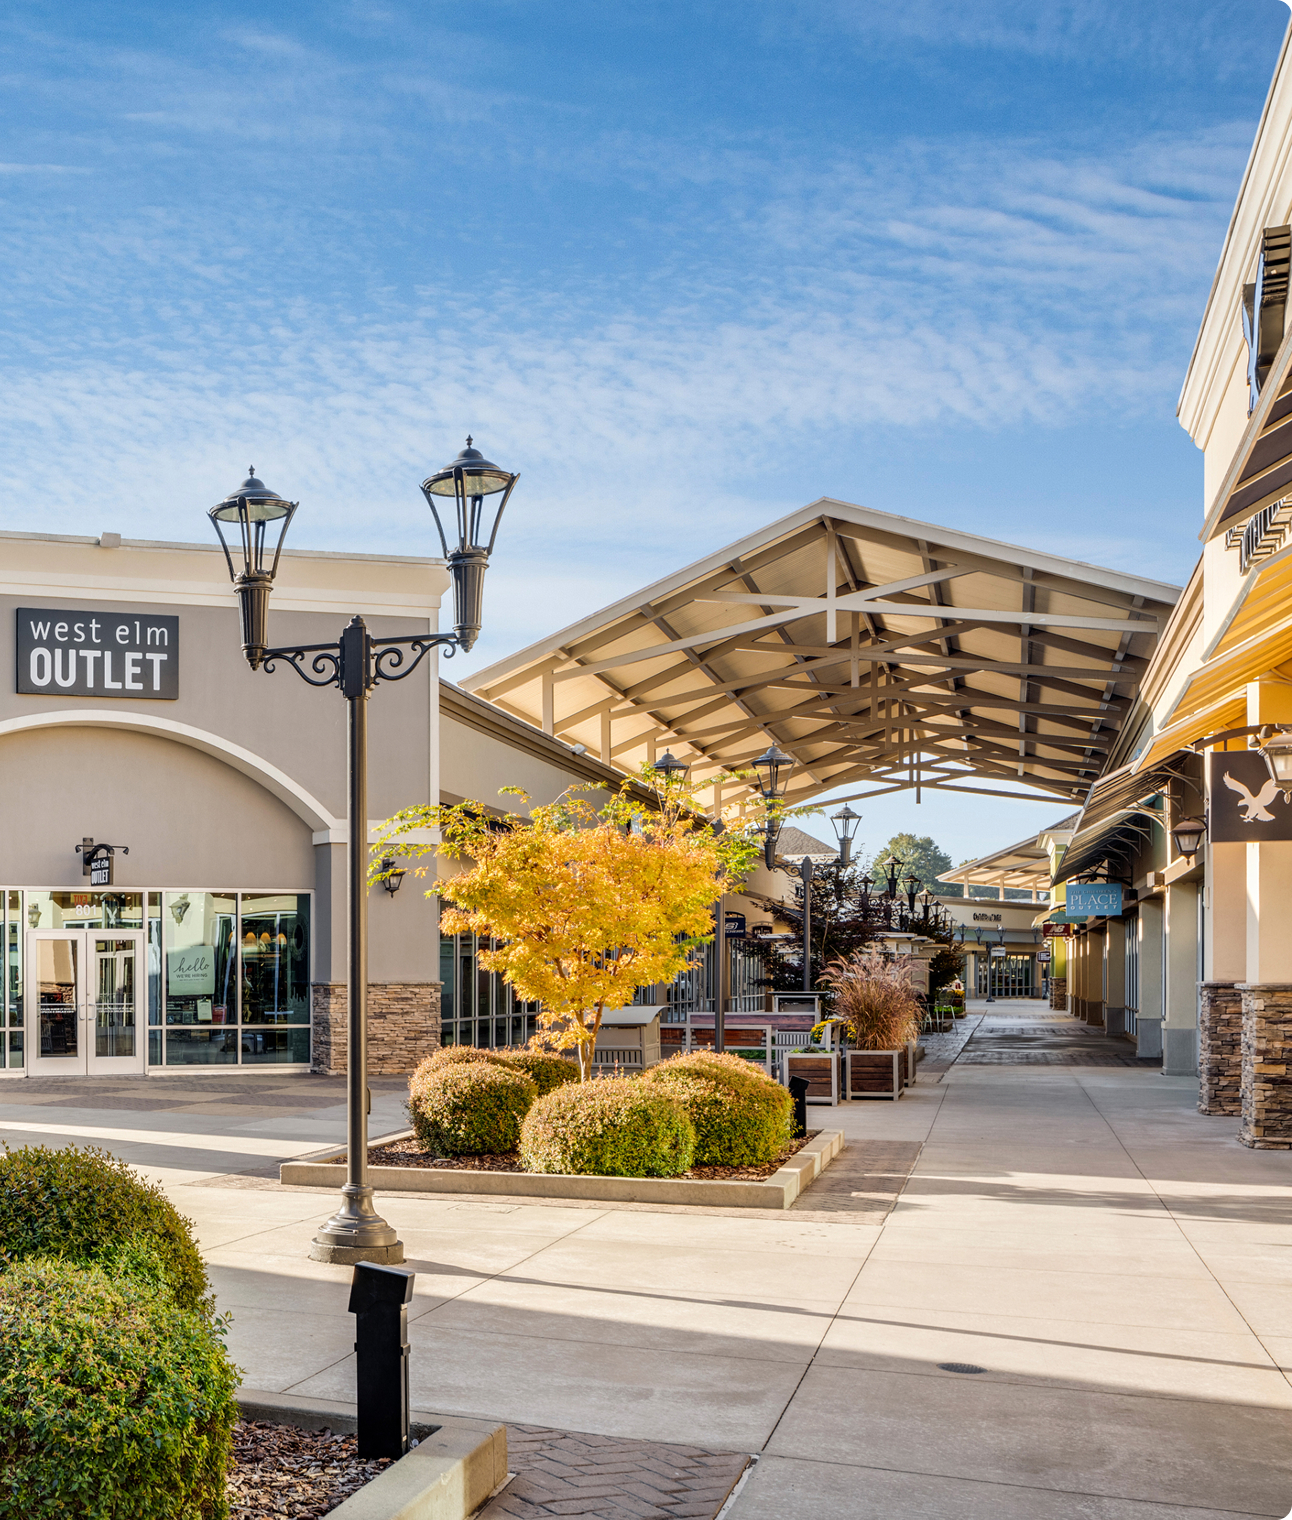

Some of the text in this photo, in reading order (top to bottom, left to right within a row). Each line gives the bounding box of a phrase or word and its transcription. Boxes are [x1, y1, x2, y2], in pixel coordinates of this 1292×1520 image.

[30, 618, 168, 646] west elm
[29, 647, 168, 691] OUTLET
[91, 858, 109, 869] west elm
[91, 869, 109, 885] OUTLET
[1070, 894, 1118, 905] PLACE
[75, 904, 97, 916] 801
[174, 957, 210, 973] hello
